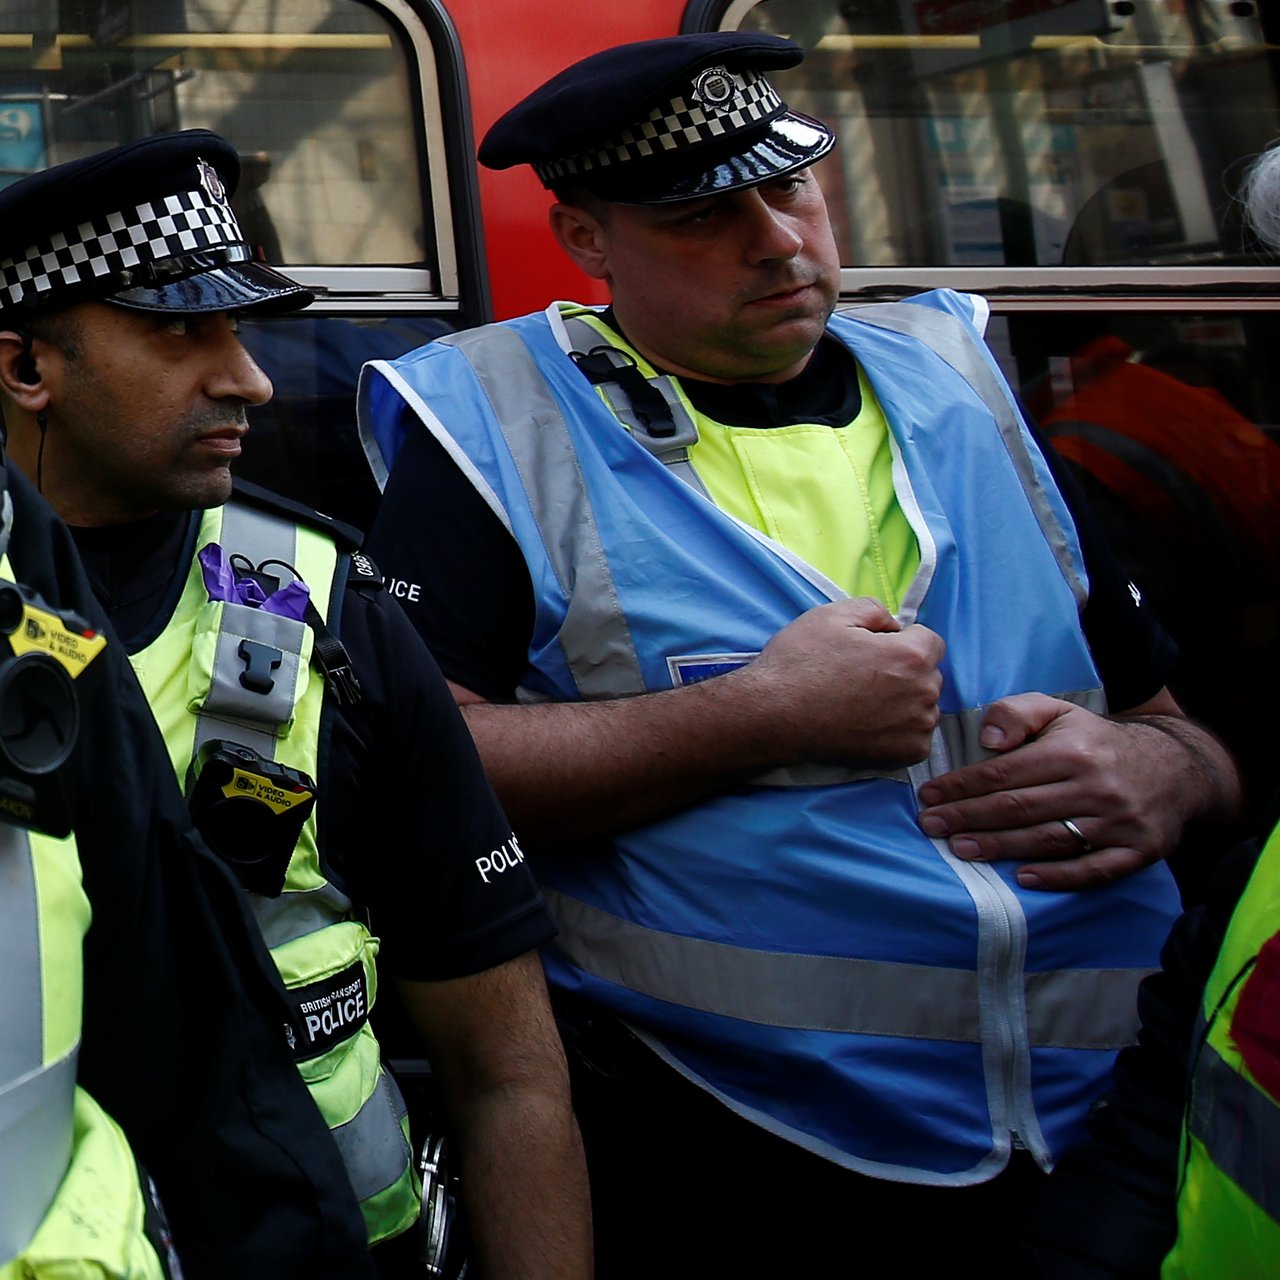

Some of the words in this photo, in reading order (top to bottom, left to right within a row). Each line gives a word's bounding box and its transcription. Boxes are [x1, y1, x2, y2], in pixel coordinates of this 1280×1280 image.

[50, 631, 79, 649] VIDEO
[258, 783, 285, 798] VIDEO
[264, 792, 292, 807] AUDIO
[299, 995, 332, 1014] BRITISH
[330, 978, 362, 1001] RANSPORT
[304, 991, 365, 1042] POLICE
